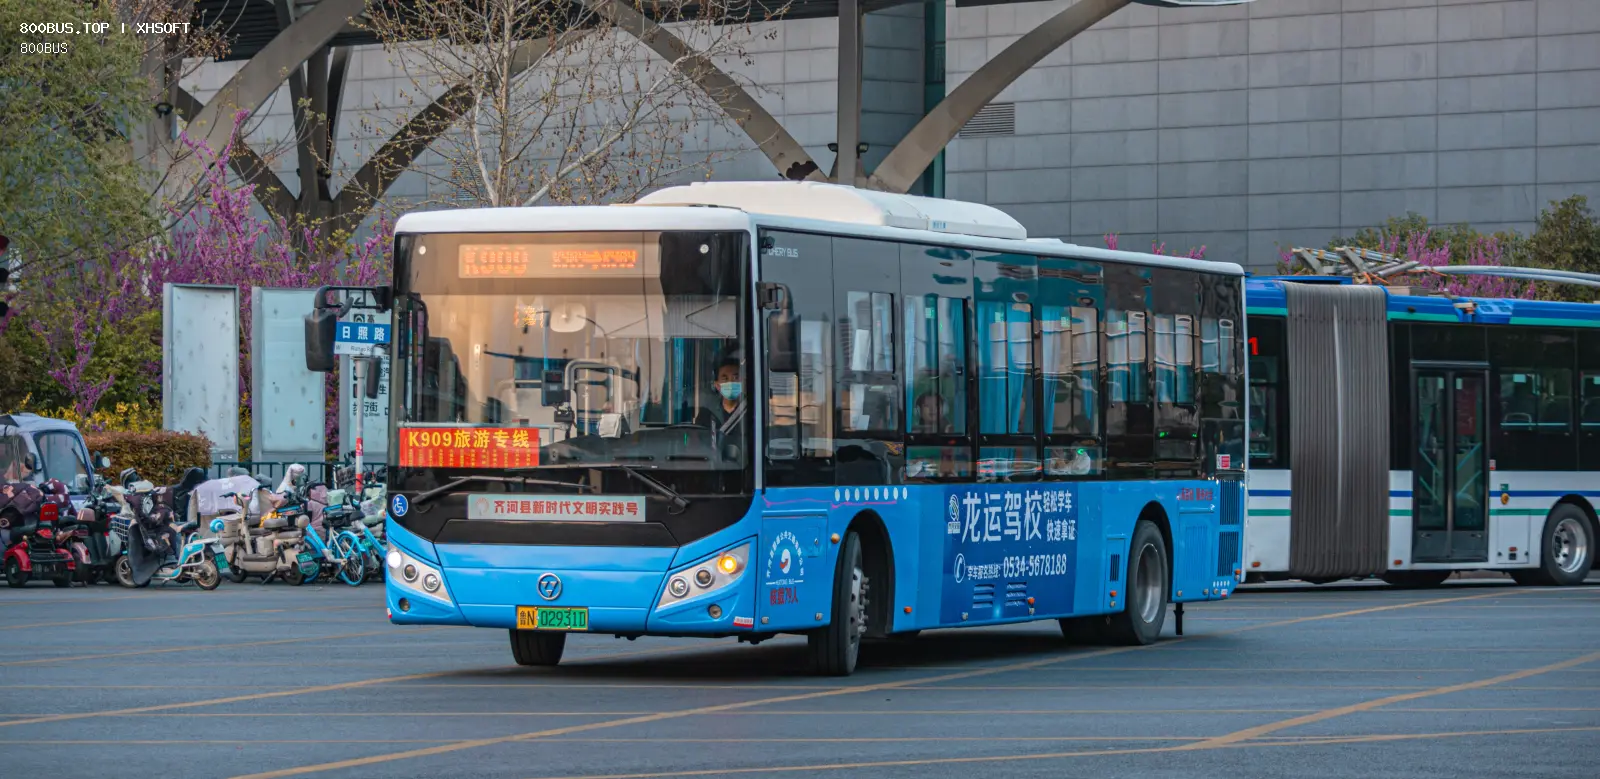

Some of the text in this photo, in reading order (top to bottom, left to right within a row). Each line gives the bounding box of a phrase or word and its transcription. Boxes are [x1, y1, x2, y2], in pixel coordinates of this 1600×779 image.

[342, 325, 385, 341] 日照路
[409, 429, 530, 449] K909旅游专线
[493, 500, 639, 516] 齐河县新时代文明实践号
[1043, 490, 1073, 513] 轻松学车
[961, 490, 1042, 543] 龙运驾校
[1046, 518, 1076, 542] 快速拿证
[1003, 553, 1067, 578] 0534-5678188
